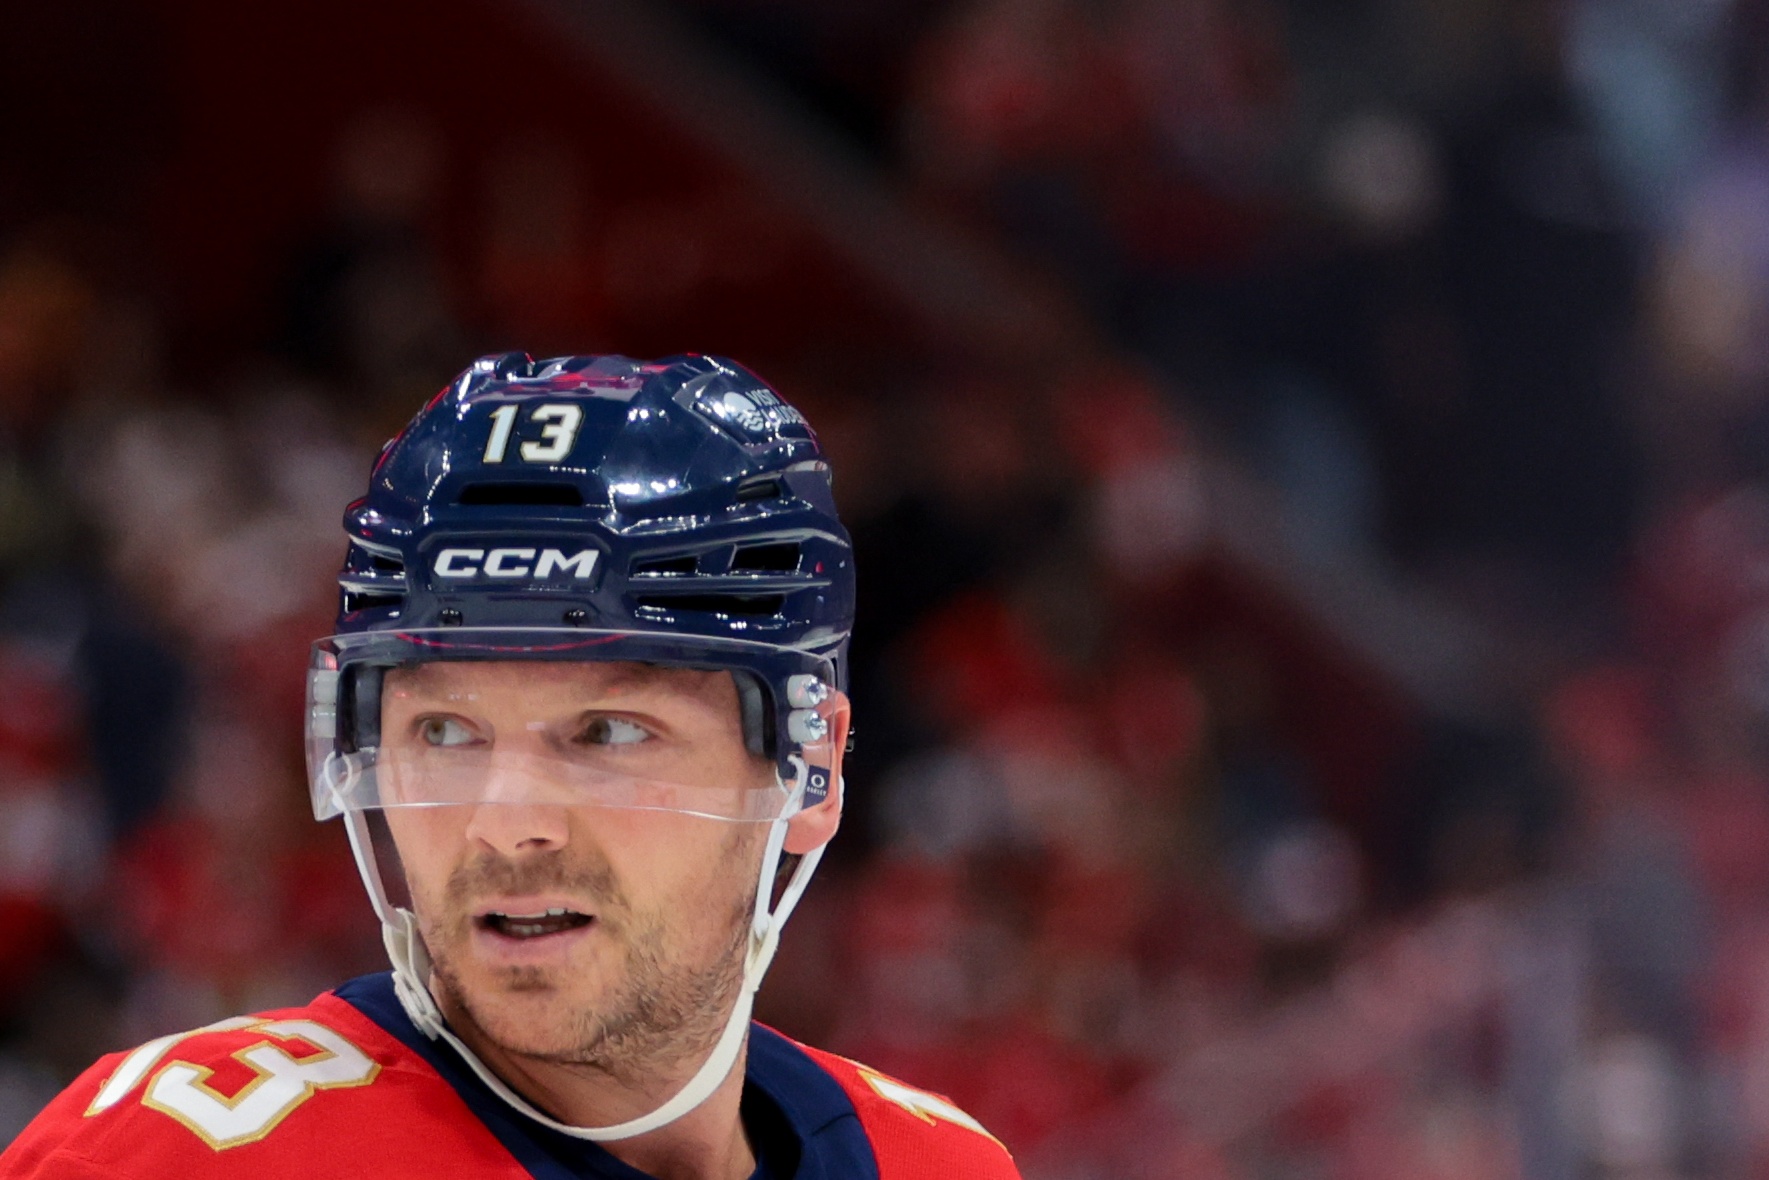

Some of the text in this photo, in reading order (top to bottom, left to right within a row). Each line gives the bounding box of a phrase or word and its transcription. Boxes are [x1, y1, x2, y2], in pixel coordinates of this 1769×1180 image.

[482, 403, 585, 464] 13
[433, 548, 600, 578] CCM
[83, 1015, 382, 1152] 13
